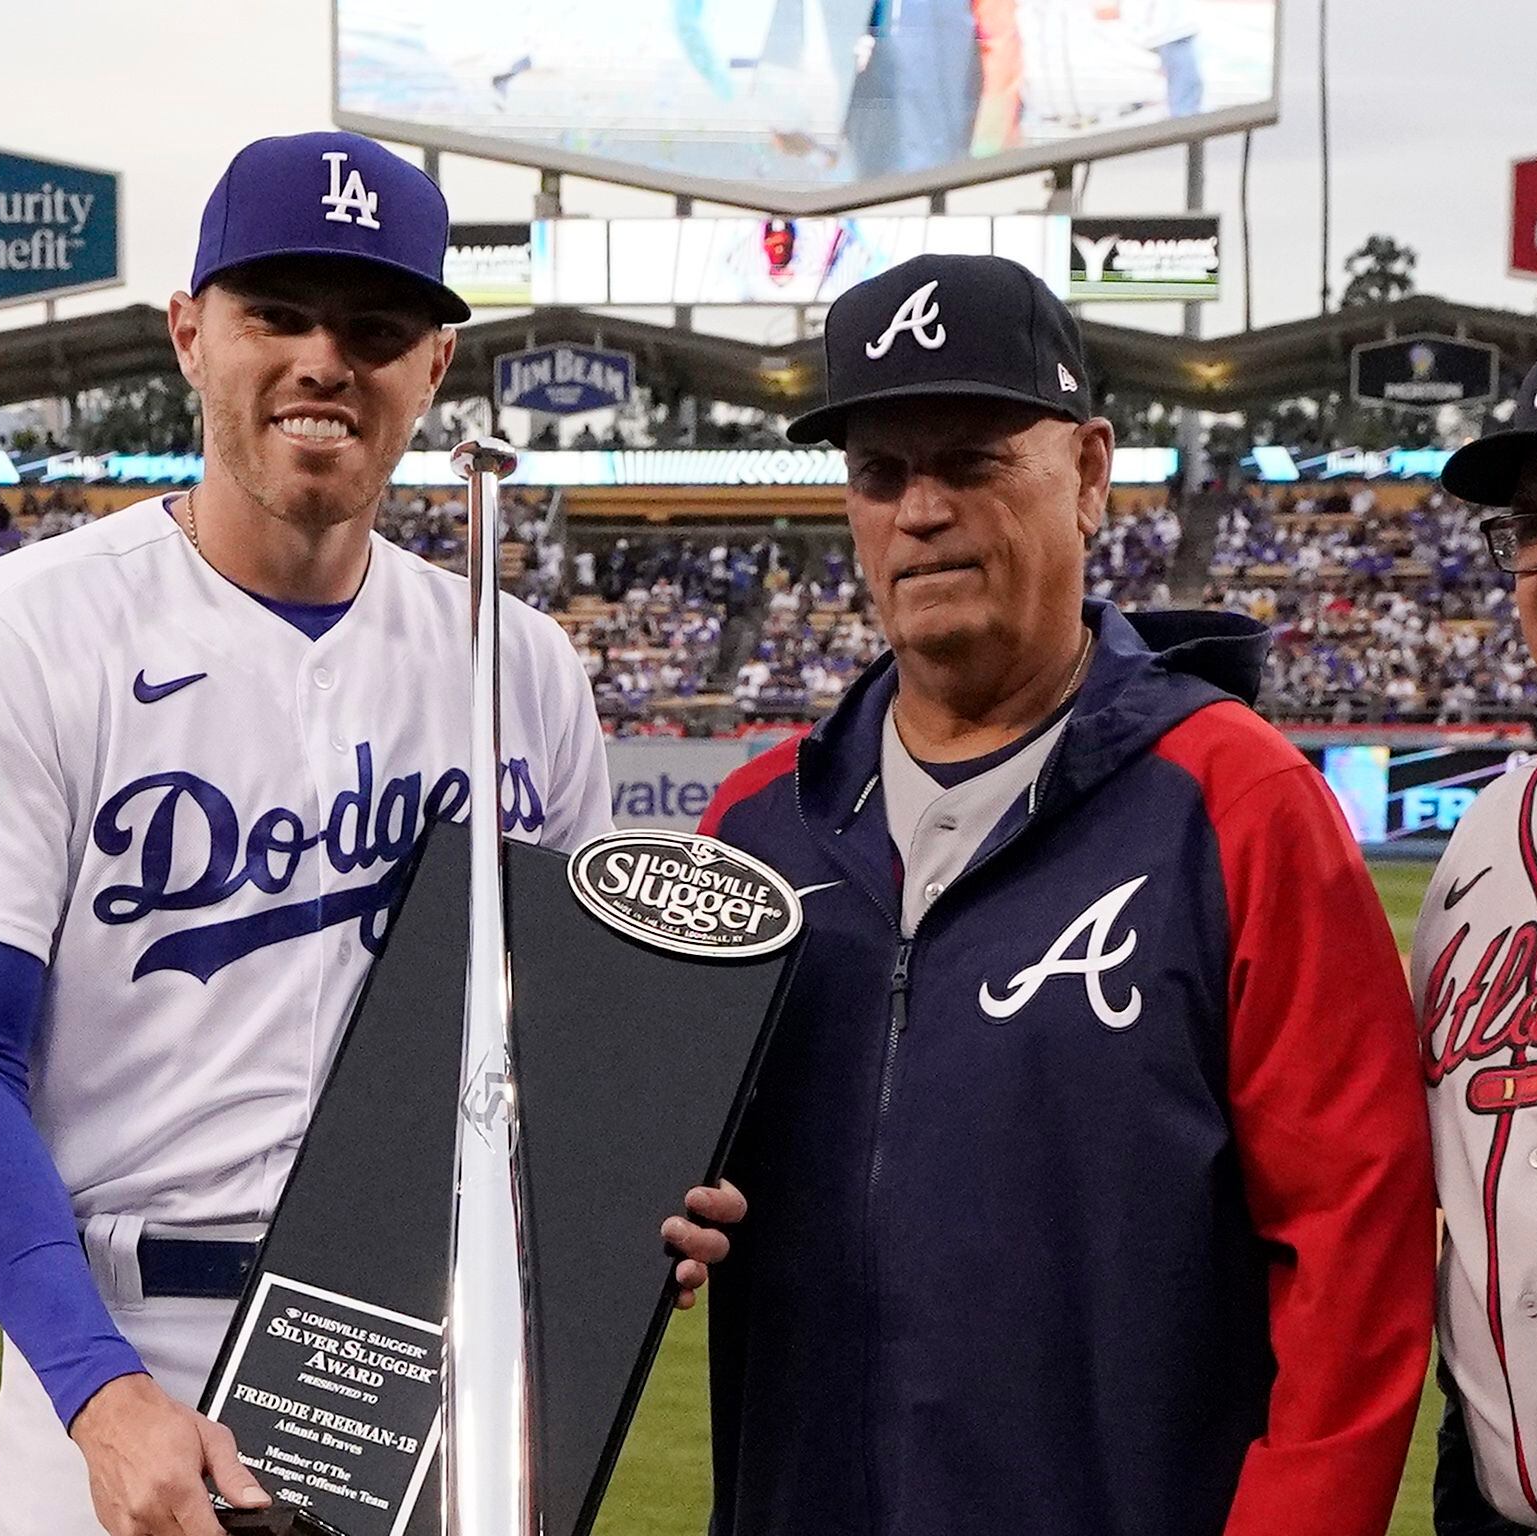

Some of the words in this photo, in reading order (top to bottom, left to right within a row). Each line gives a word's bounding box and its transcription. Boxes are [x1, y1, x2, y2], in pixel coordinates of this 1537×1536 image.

[321, 151, 381, 231] LA
[866, 280, 945, 359] A
[597, 851, 776, 935] Slugger
[648, 855, 771, 904] LOUISVILLE
[978, 873, 1149, 1029] A
[301, 1311, 367, 1342] LOUISVILLE
[297, 1372, 362, 1400] PRESENTED
[361, 1391, 379, 1405] TO
[233, 1384, 311, 1420] FREDDIE
[309, 1407, 419, 1454] FREEMAN-1B
[274, 1418, 320, 1442] Atlanta
[320, 1433, 364, 1456] Braves
[265, 1445, 313, 1469] Member
[313, 1459, 332, 1474] Of
[331, 1468, 352, 1482] The
[265, 1464, 306, 1484] League
[305, 1473, 359, 1500] Offensive
[359, 1490, 390, 1510] Team
